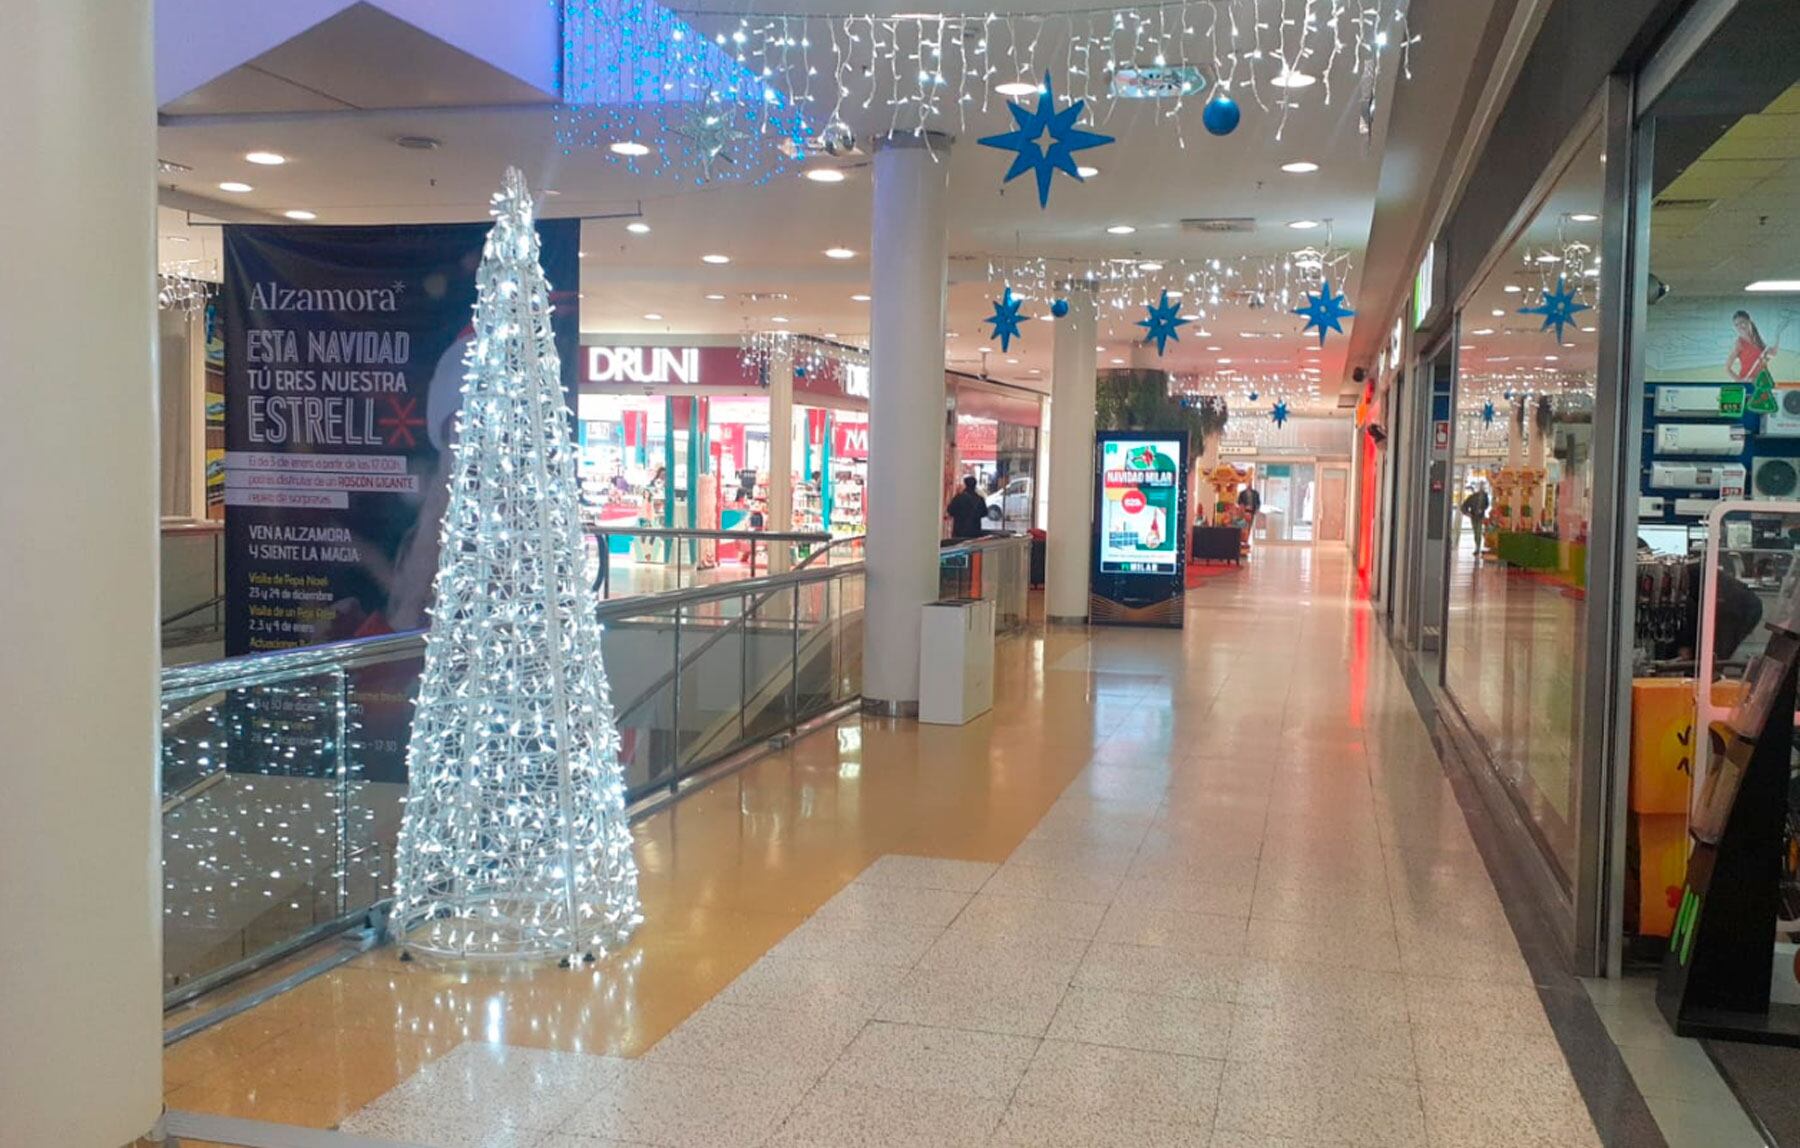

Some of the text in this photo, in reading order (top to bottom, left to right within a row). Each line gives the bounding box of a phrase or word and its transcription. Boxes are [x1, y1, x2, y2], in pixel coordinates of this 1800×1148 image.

[249, 281, 396, 311] Alzamora
[247, 330, 410, 364] ESTA NAVIDAD
[588, 346, 699, 383] DRUNI
[247, 366, 408, 392] TÚ ERES NUESTRA
[249, 525, 352, 542] VEN A ALZAMORA
[260, 545, 300, 560] SIENTE
[302, 546, 318, 561] LA
[320, 547, 360, 562] MAGIA
